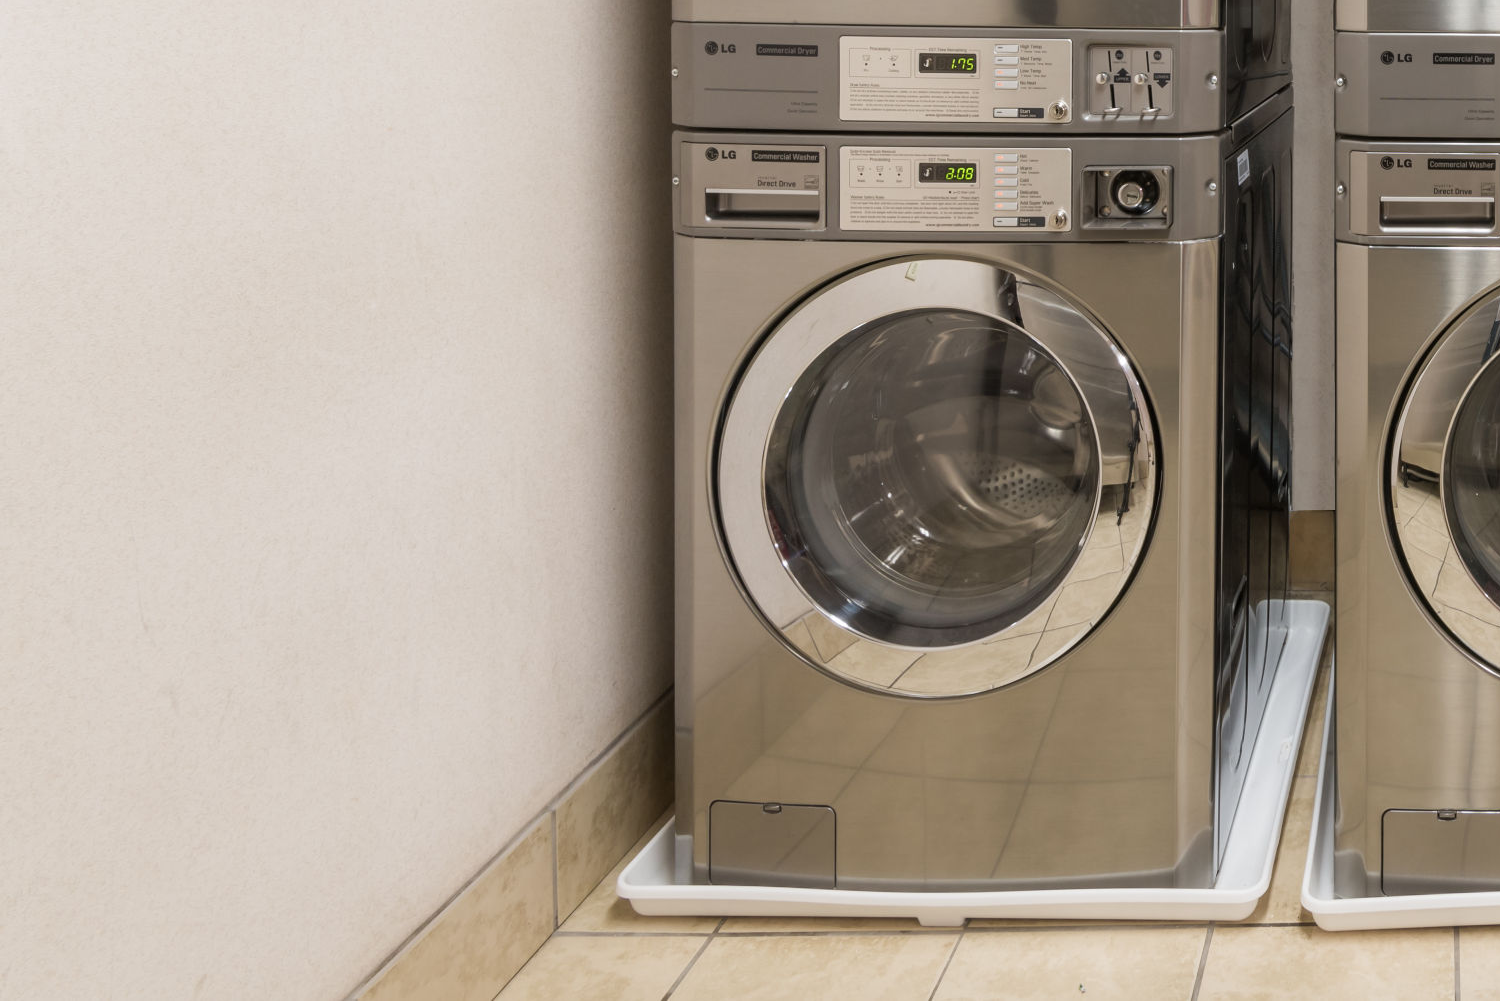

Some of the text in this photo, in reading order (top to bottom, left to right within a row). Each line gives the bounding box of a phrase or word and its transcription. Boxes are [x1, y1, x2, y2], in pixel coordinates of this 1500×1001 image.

[721, 44, 736, 54] LG
[758, 46, 817, 56] Commercial Dryer
[1397, 54, 1413, 62] LG
[1434, 55, 1493, 64] Commercial Dryer
[951, 58, 974, 71] 1.75
[721, 150, 737, 159] LG
[753, 152, 818, 161] Commercial Washer
[1397, 159, 1412, 168] LG
[1469, 161, 1494, 169] Washer
[778, 180, 796, 188] Drive
[1433, 187, 1453, 195] Direct
